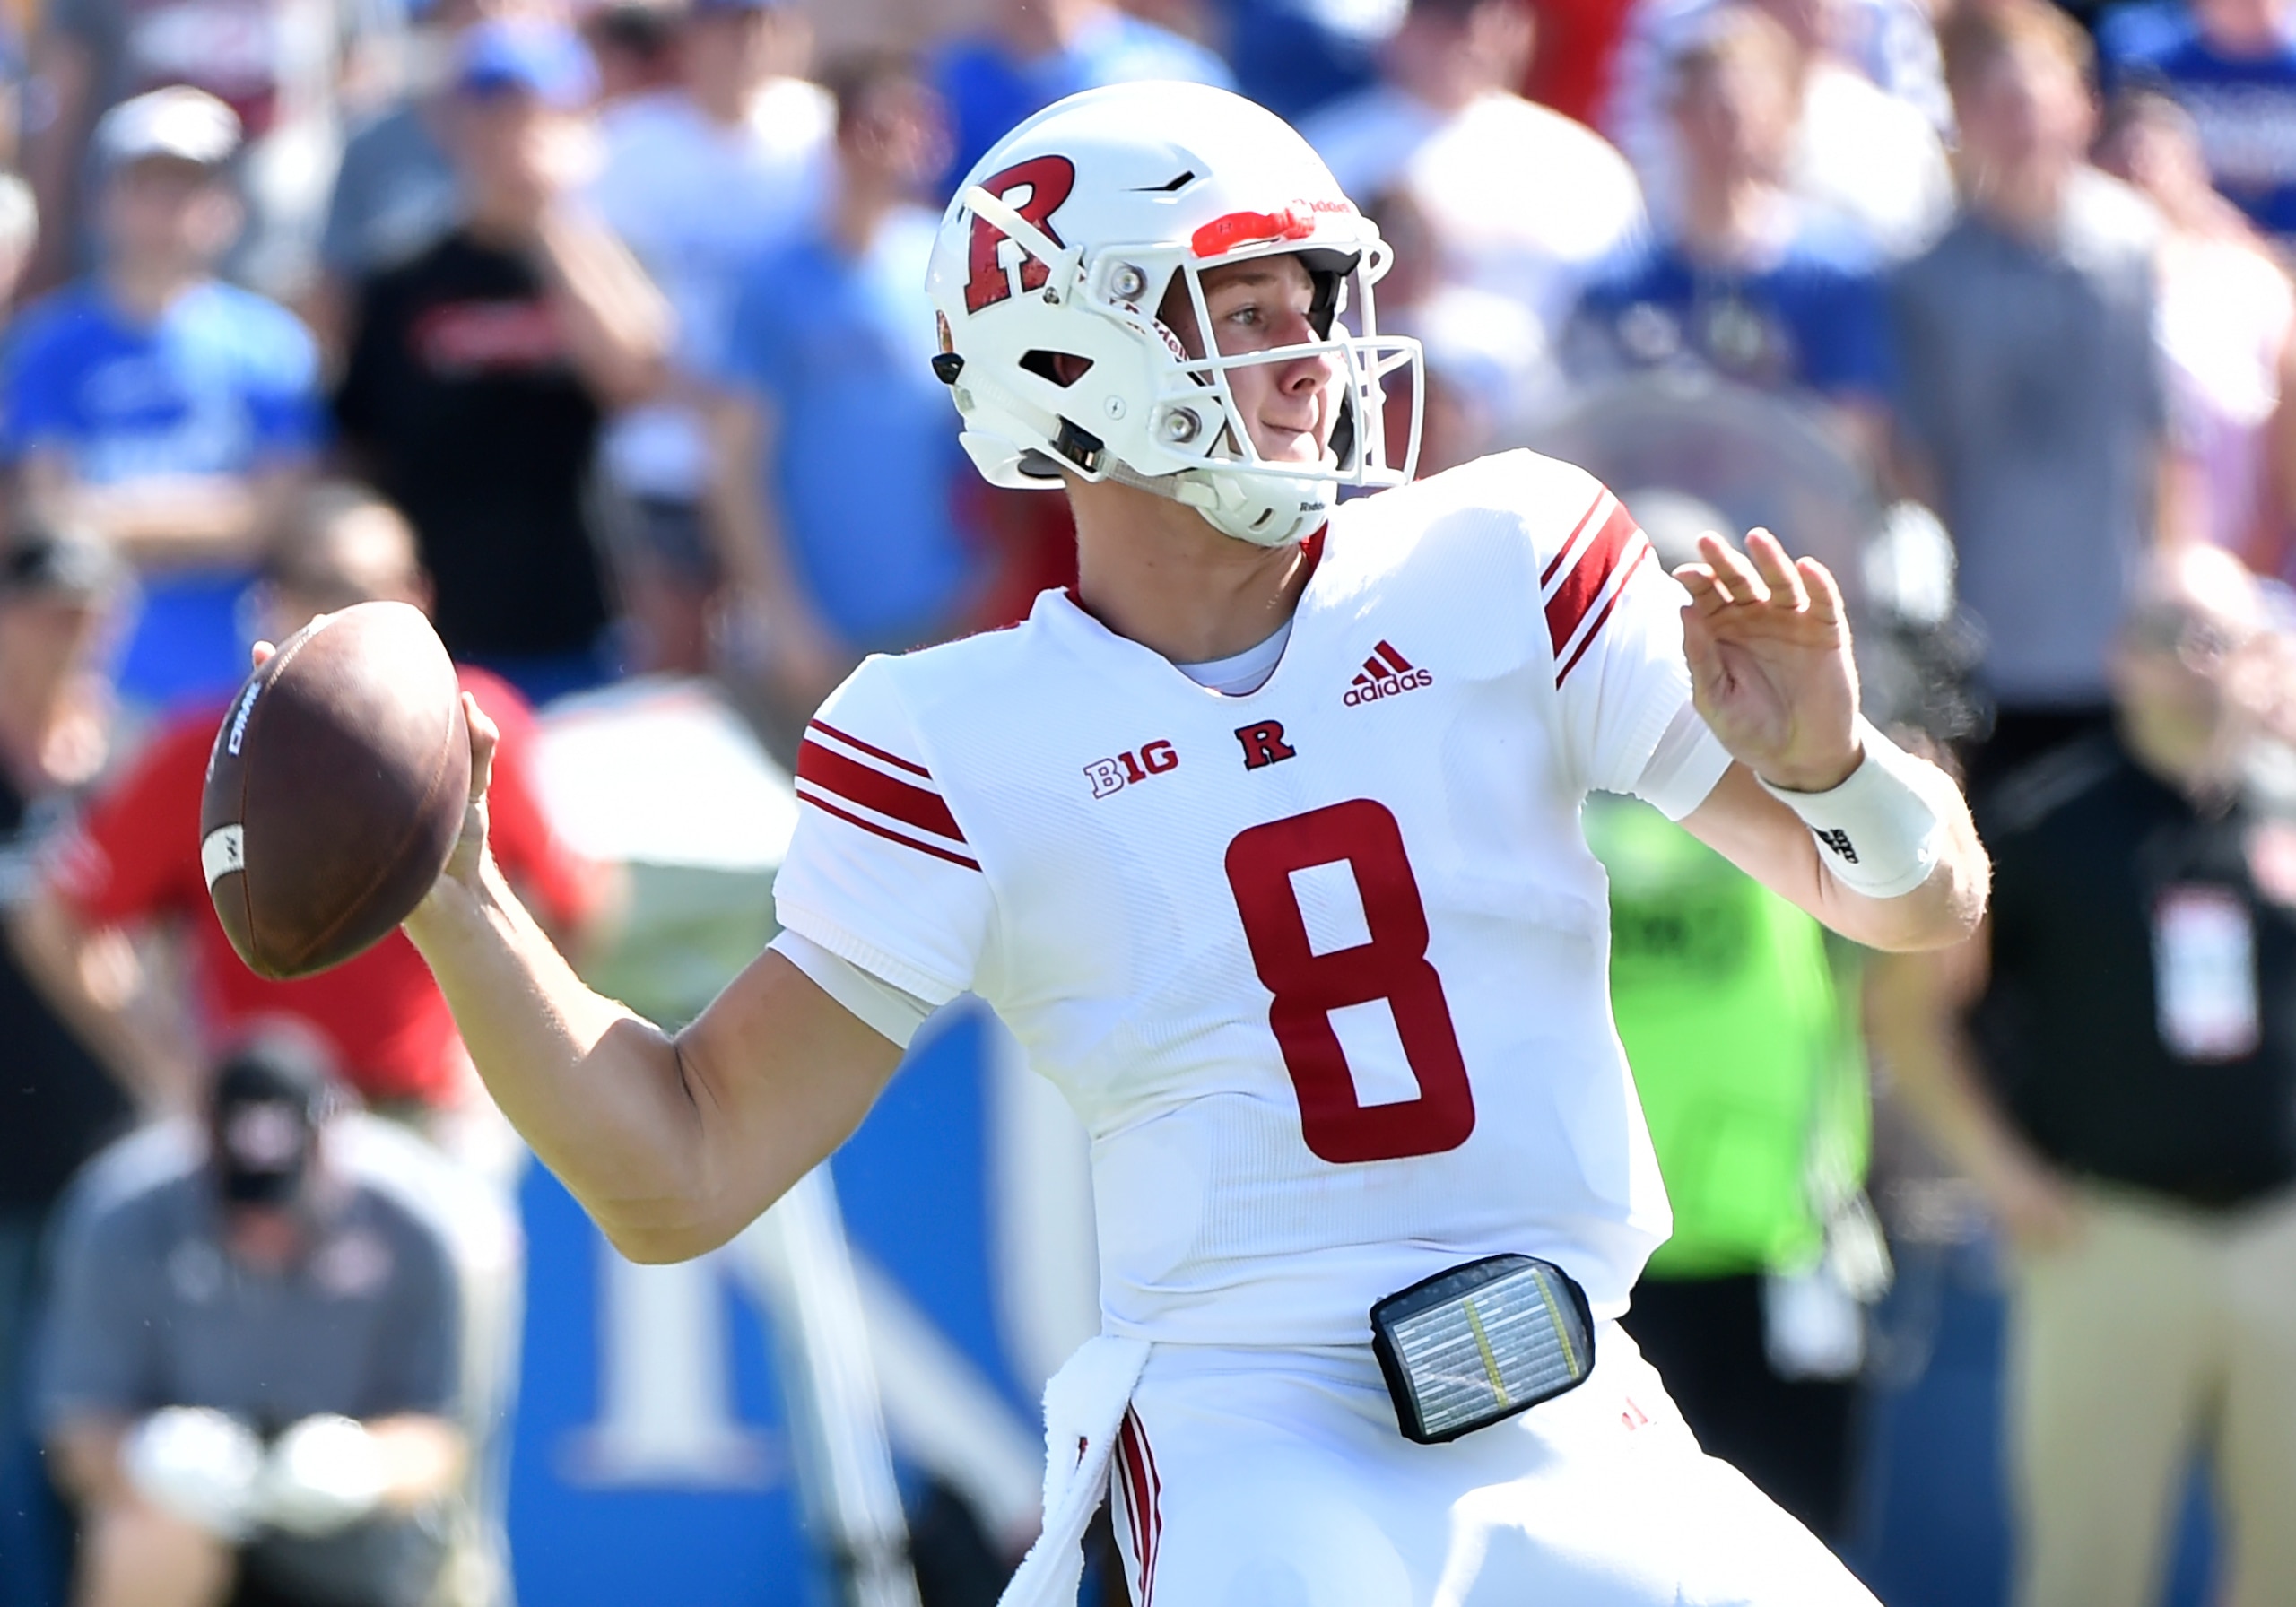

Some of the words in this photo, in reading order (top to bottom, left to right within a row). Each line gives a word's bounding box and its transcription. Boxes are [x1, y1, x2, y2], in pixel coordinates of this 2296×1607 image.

[964, 155, 1075, 315] R
[1343, 668, 1433, 707] adidas
[1234, 720, 1297, 772] R
[1224, 798, 1476, 1164] 8
